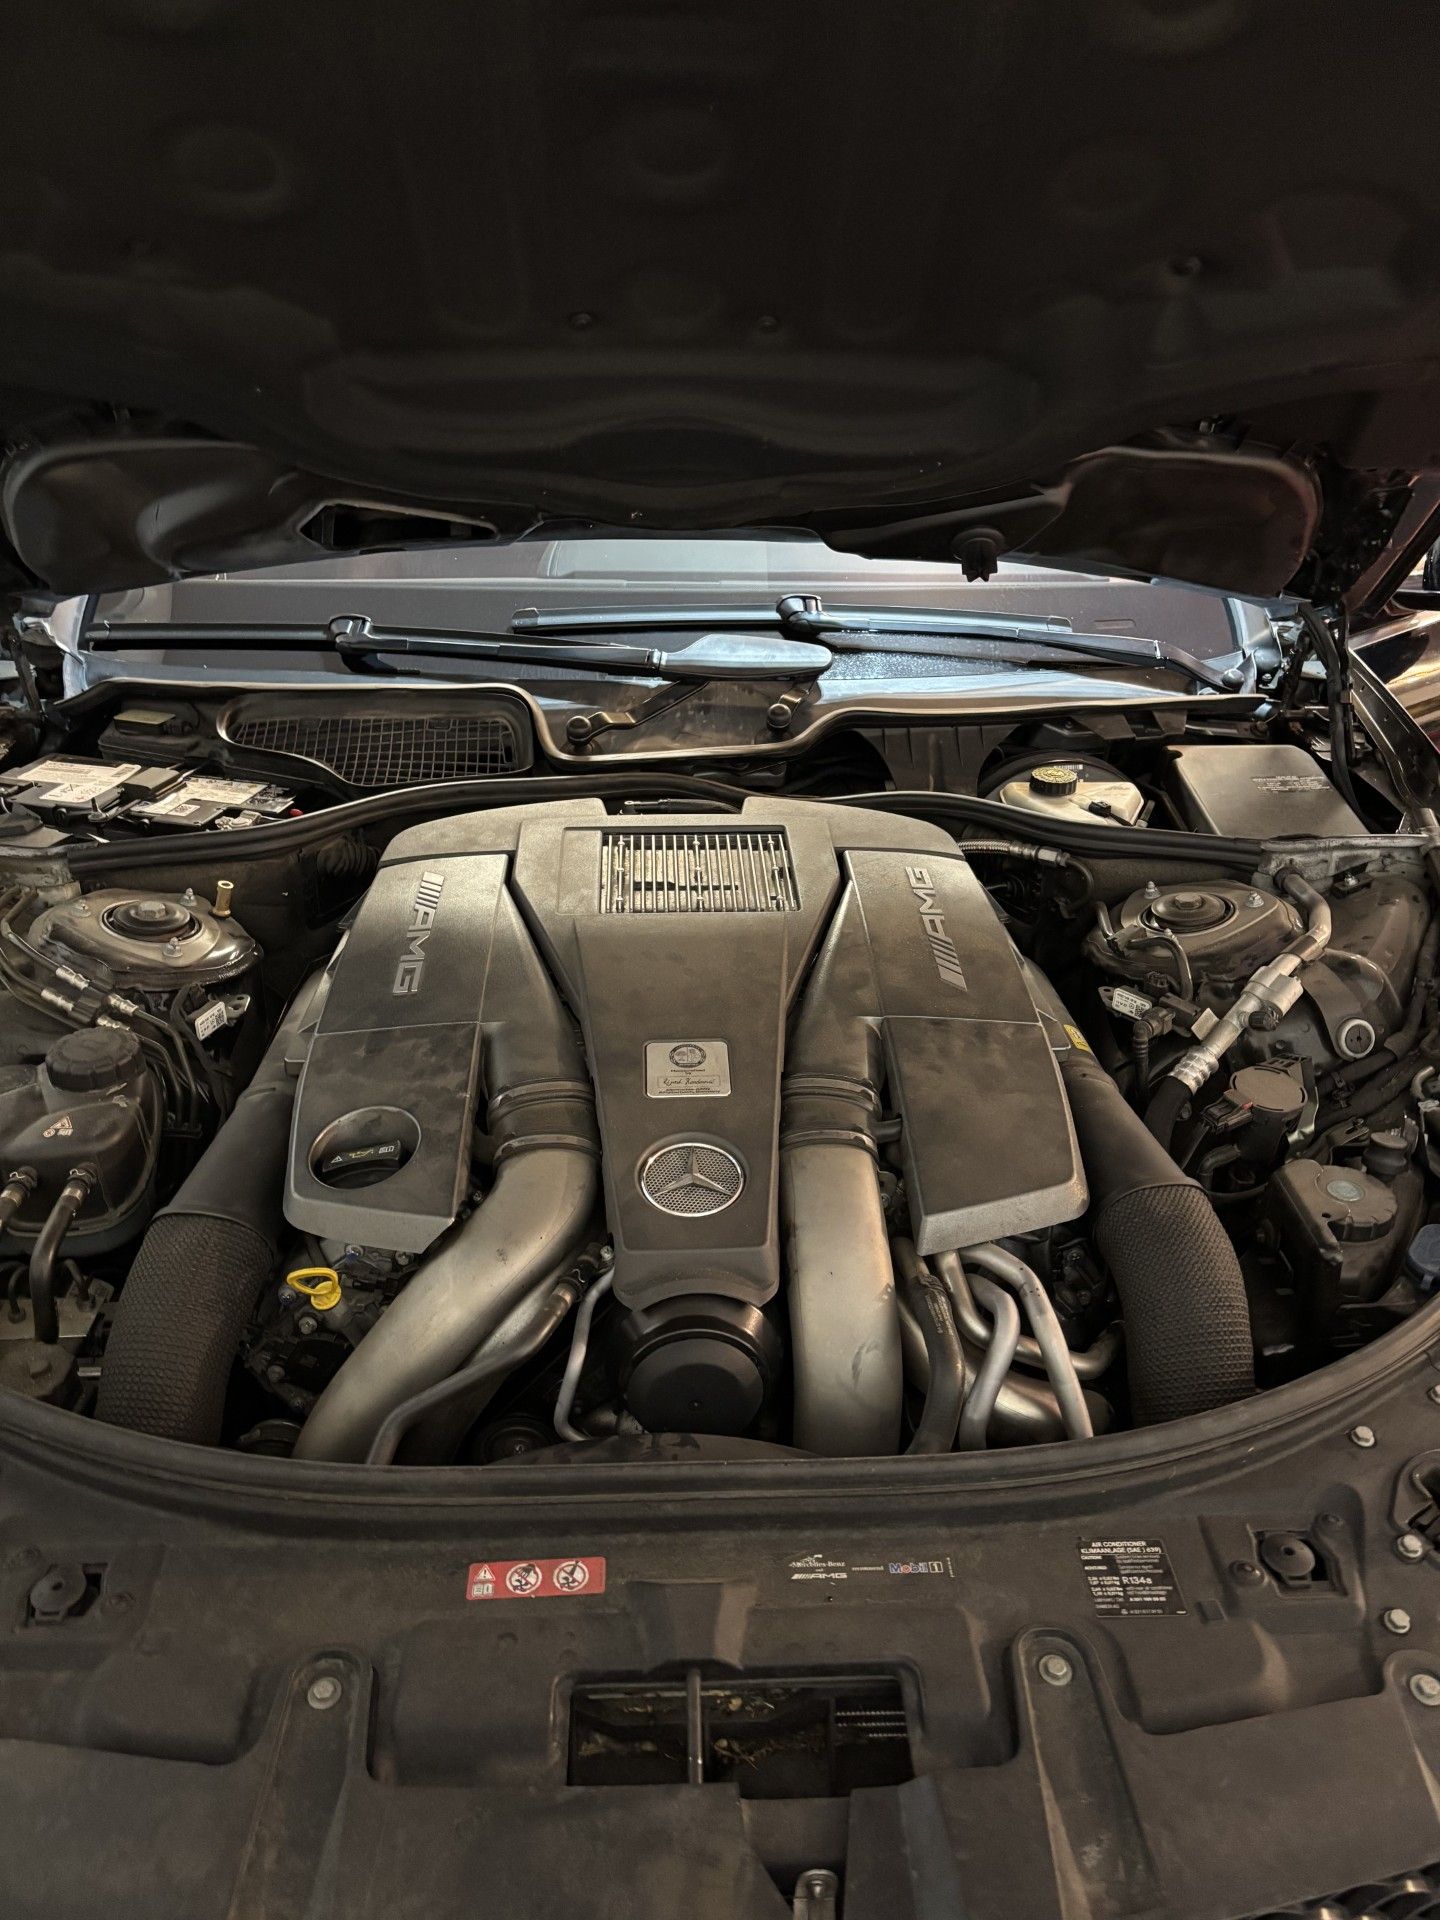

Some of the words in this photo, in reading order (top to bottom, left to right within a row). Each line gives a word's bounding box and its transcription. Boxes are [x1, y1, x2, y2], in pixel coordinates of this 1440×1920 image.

[905, 866, 947, 937] AMG
[392, 903, 436, 996] AMG
[788, 1560, 847, 1568] Mercedes-Benz
[888, 1561, 929, 1574] Mobil
